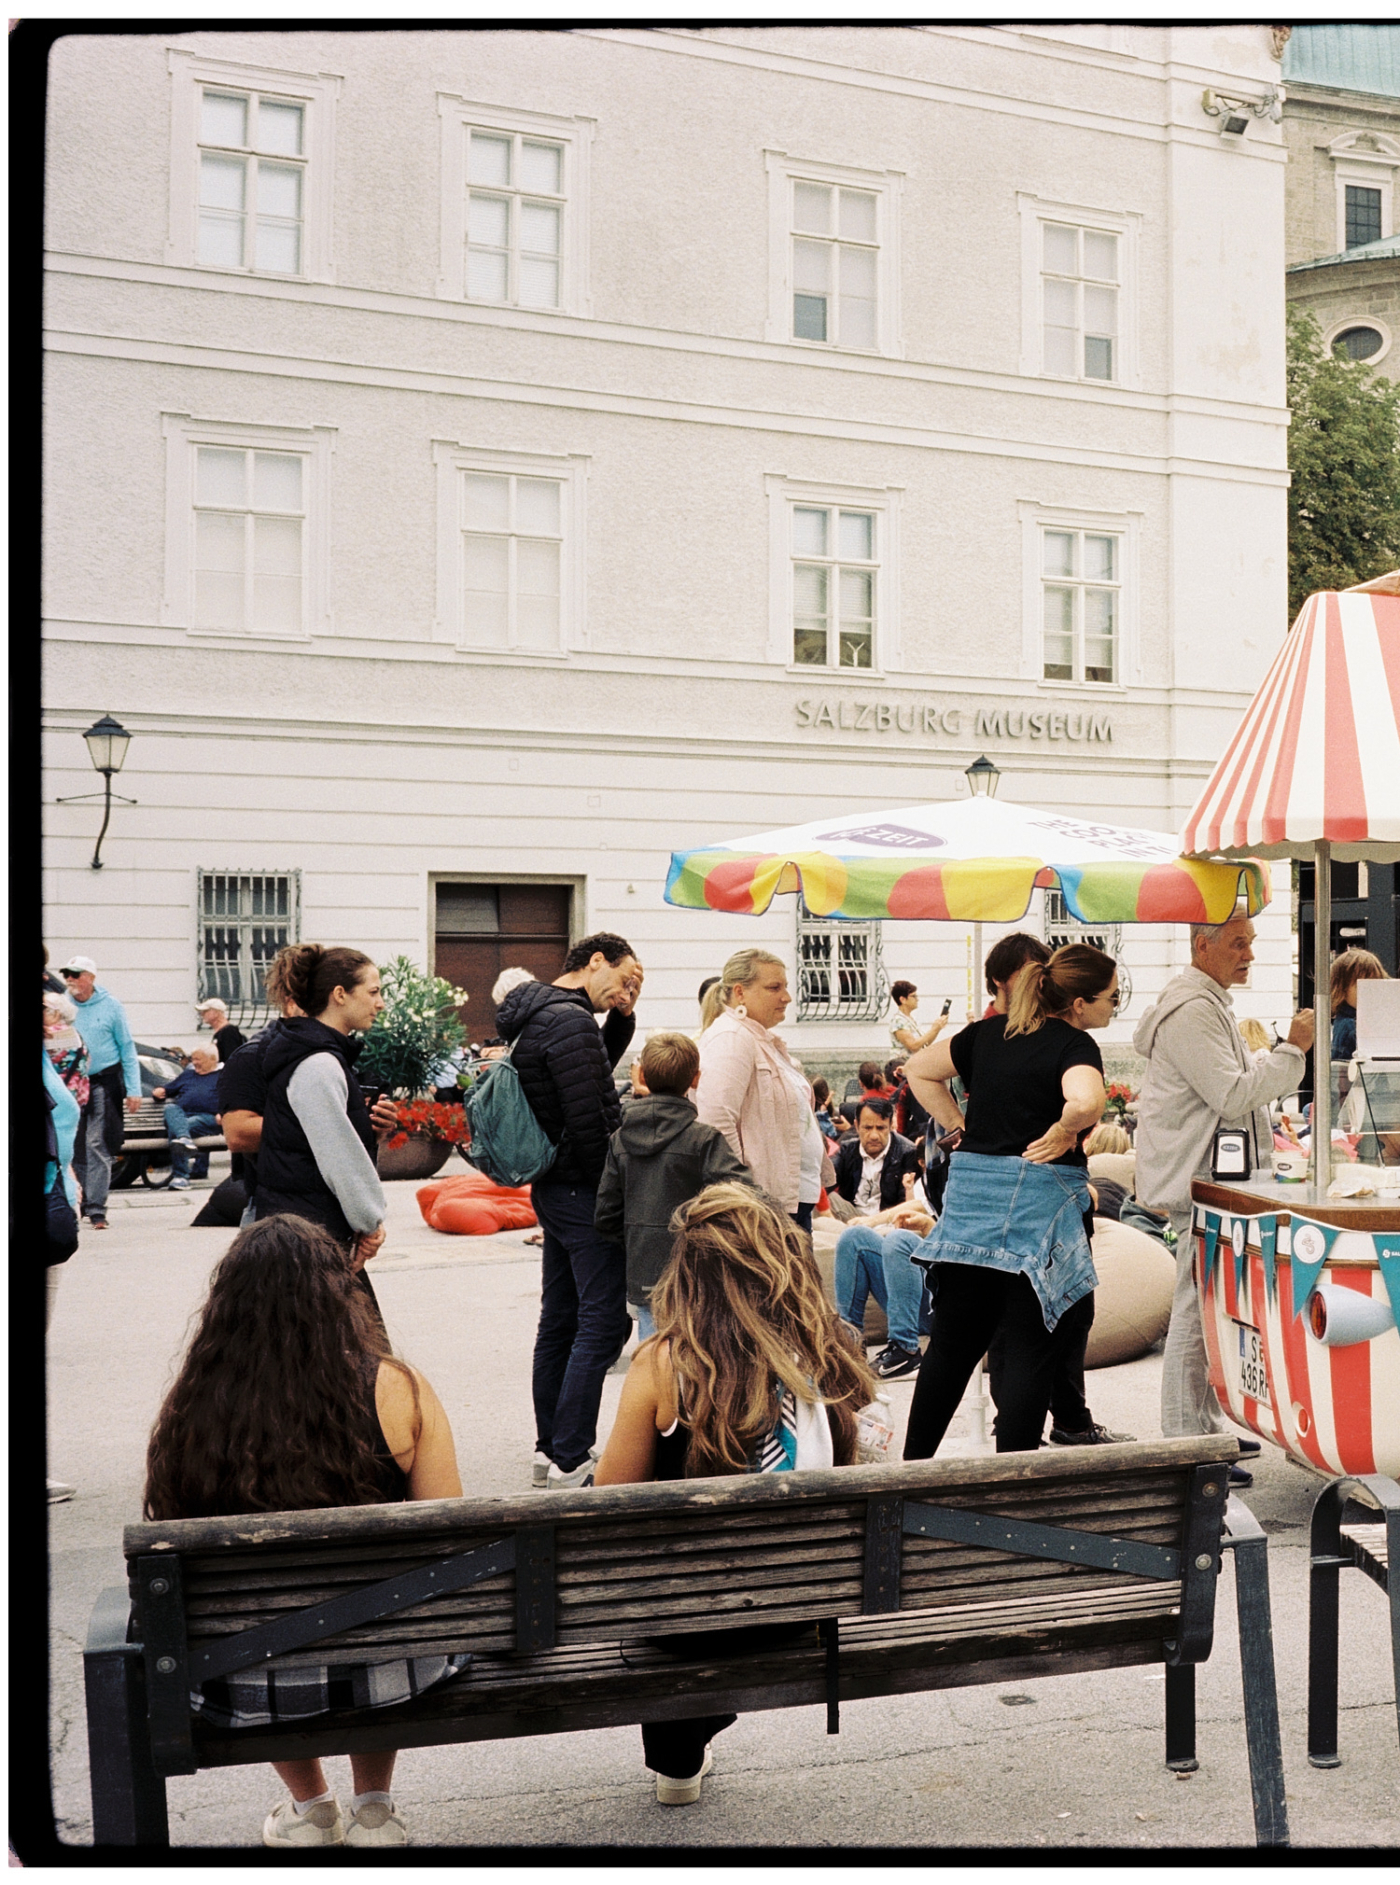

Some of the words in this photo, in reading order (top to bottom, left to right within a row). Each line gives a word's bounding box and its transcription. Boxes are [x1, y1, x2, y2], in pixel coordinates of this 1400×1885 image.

[795, 699, 963, 735] SALZBURG
[975, 707, 1114, 742] MUSEUM
[1026, 818, 1079, 831] THE
[1059, 825, 1117, 839] COO
[1251, 1335, 1258, 1363] S
[1240, 1360, 1258, 1393] 436
